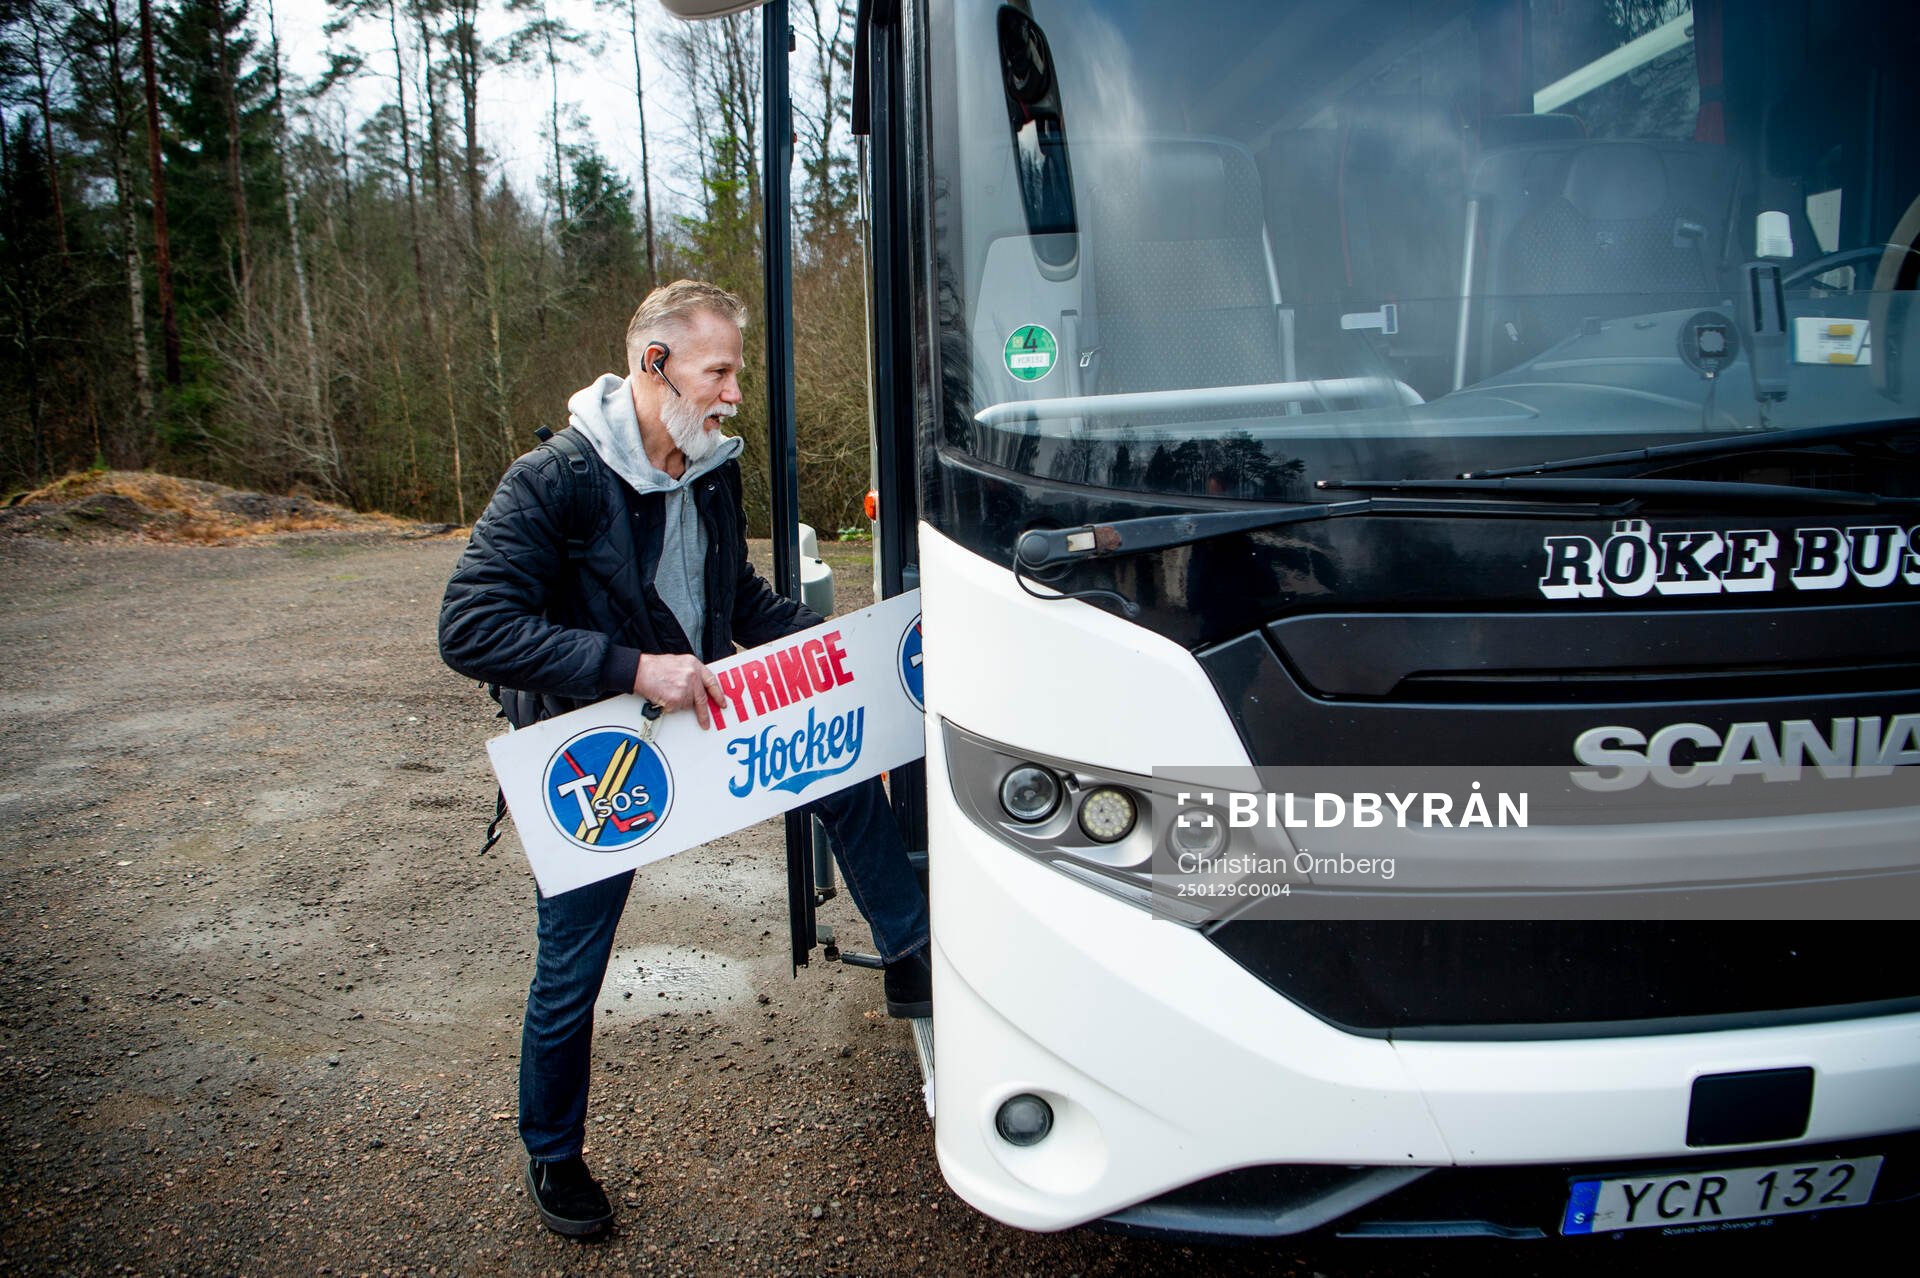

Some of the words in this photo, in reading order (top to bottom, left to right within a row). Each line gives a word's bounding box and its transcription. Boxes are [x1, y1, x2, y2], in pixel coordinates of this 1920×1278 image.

[1023, 328, 1038, 353] 4
[1539, 519, 1779, 599] RÖKE
[727, 706, 865, 798] Hockey
[1569, 713, 1920, 792] SCANIA
[1574, 1212, 1585, 1225] S
[1621, 1175, 1728, 1222] YCR
[1756, 1163, 1856, 1211] 132
